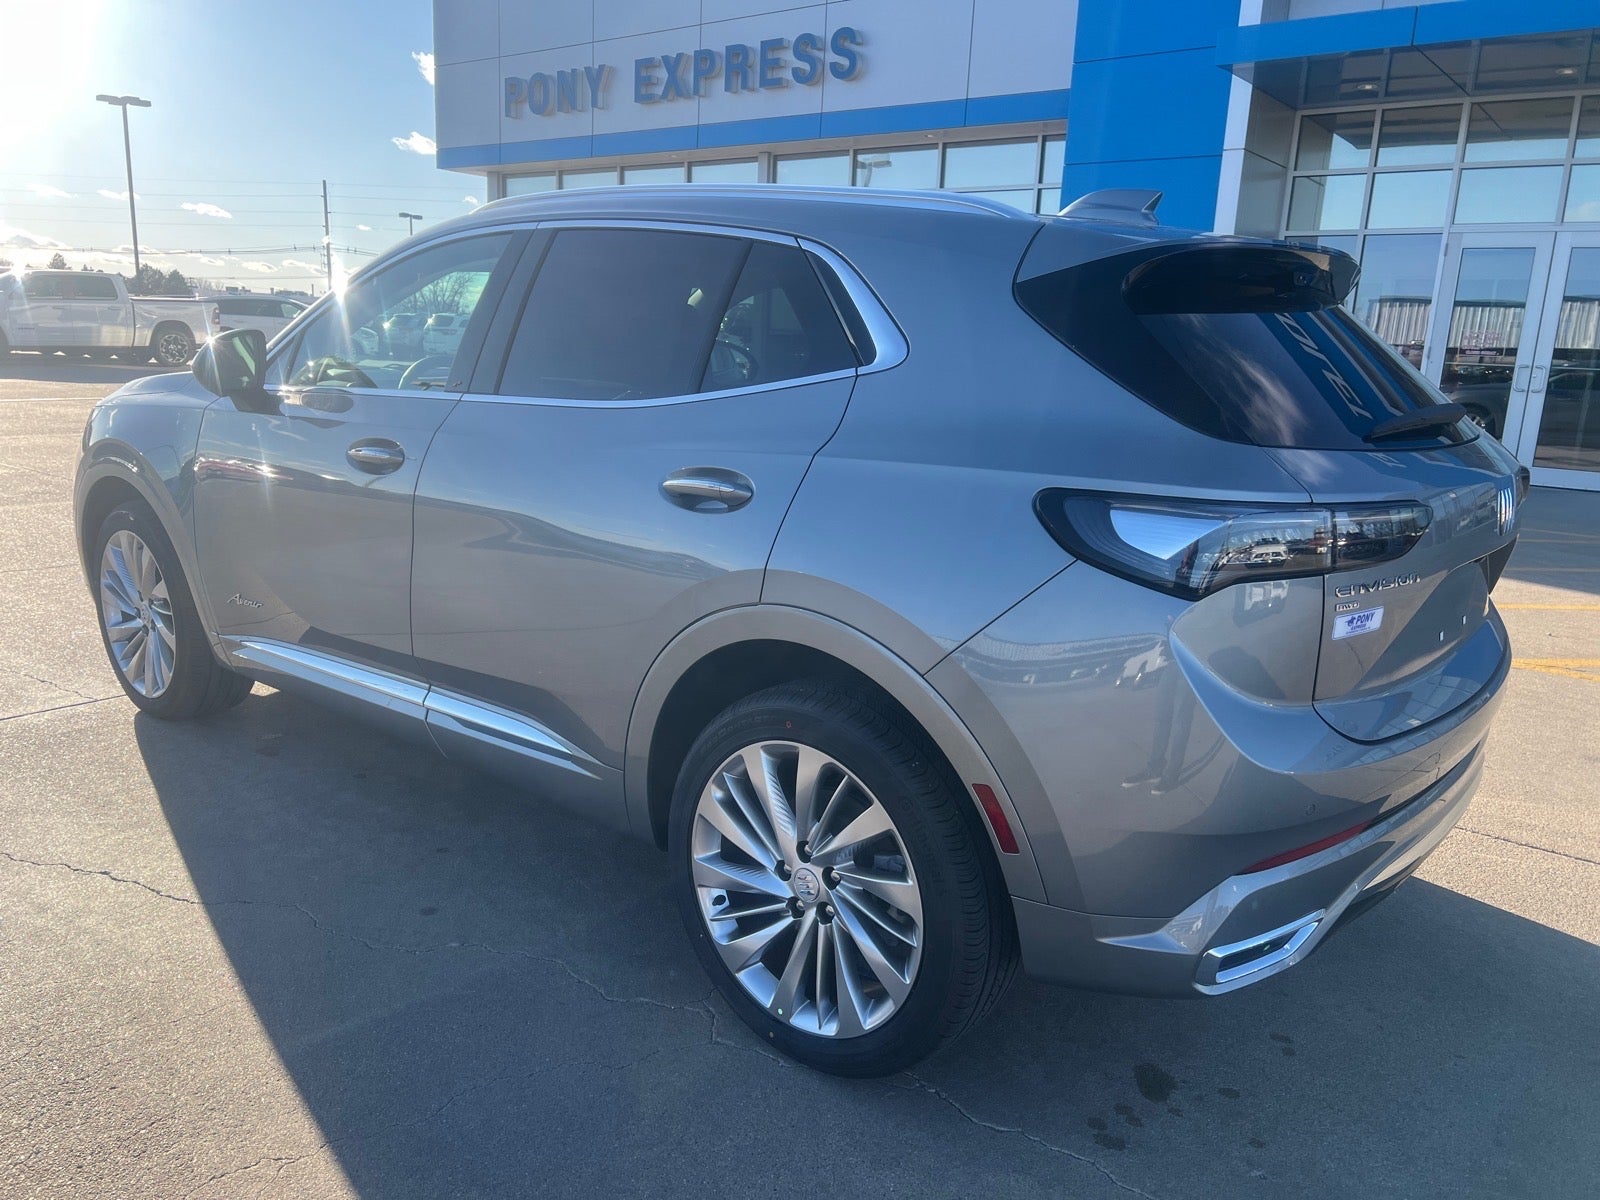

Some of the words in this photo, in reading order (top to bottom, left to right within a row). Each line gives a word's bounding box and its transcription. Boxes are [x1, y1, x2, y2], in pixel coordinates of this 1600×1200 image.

[505, 64, 615, 119] PONY
[634, 26, 864, 104] EXPRESS
[226, 593, 262, 608] Avenir
[1355, 611, 1376, 625] PONY
